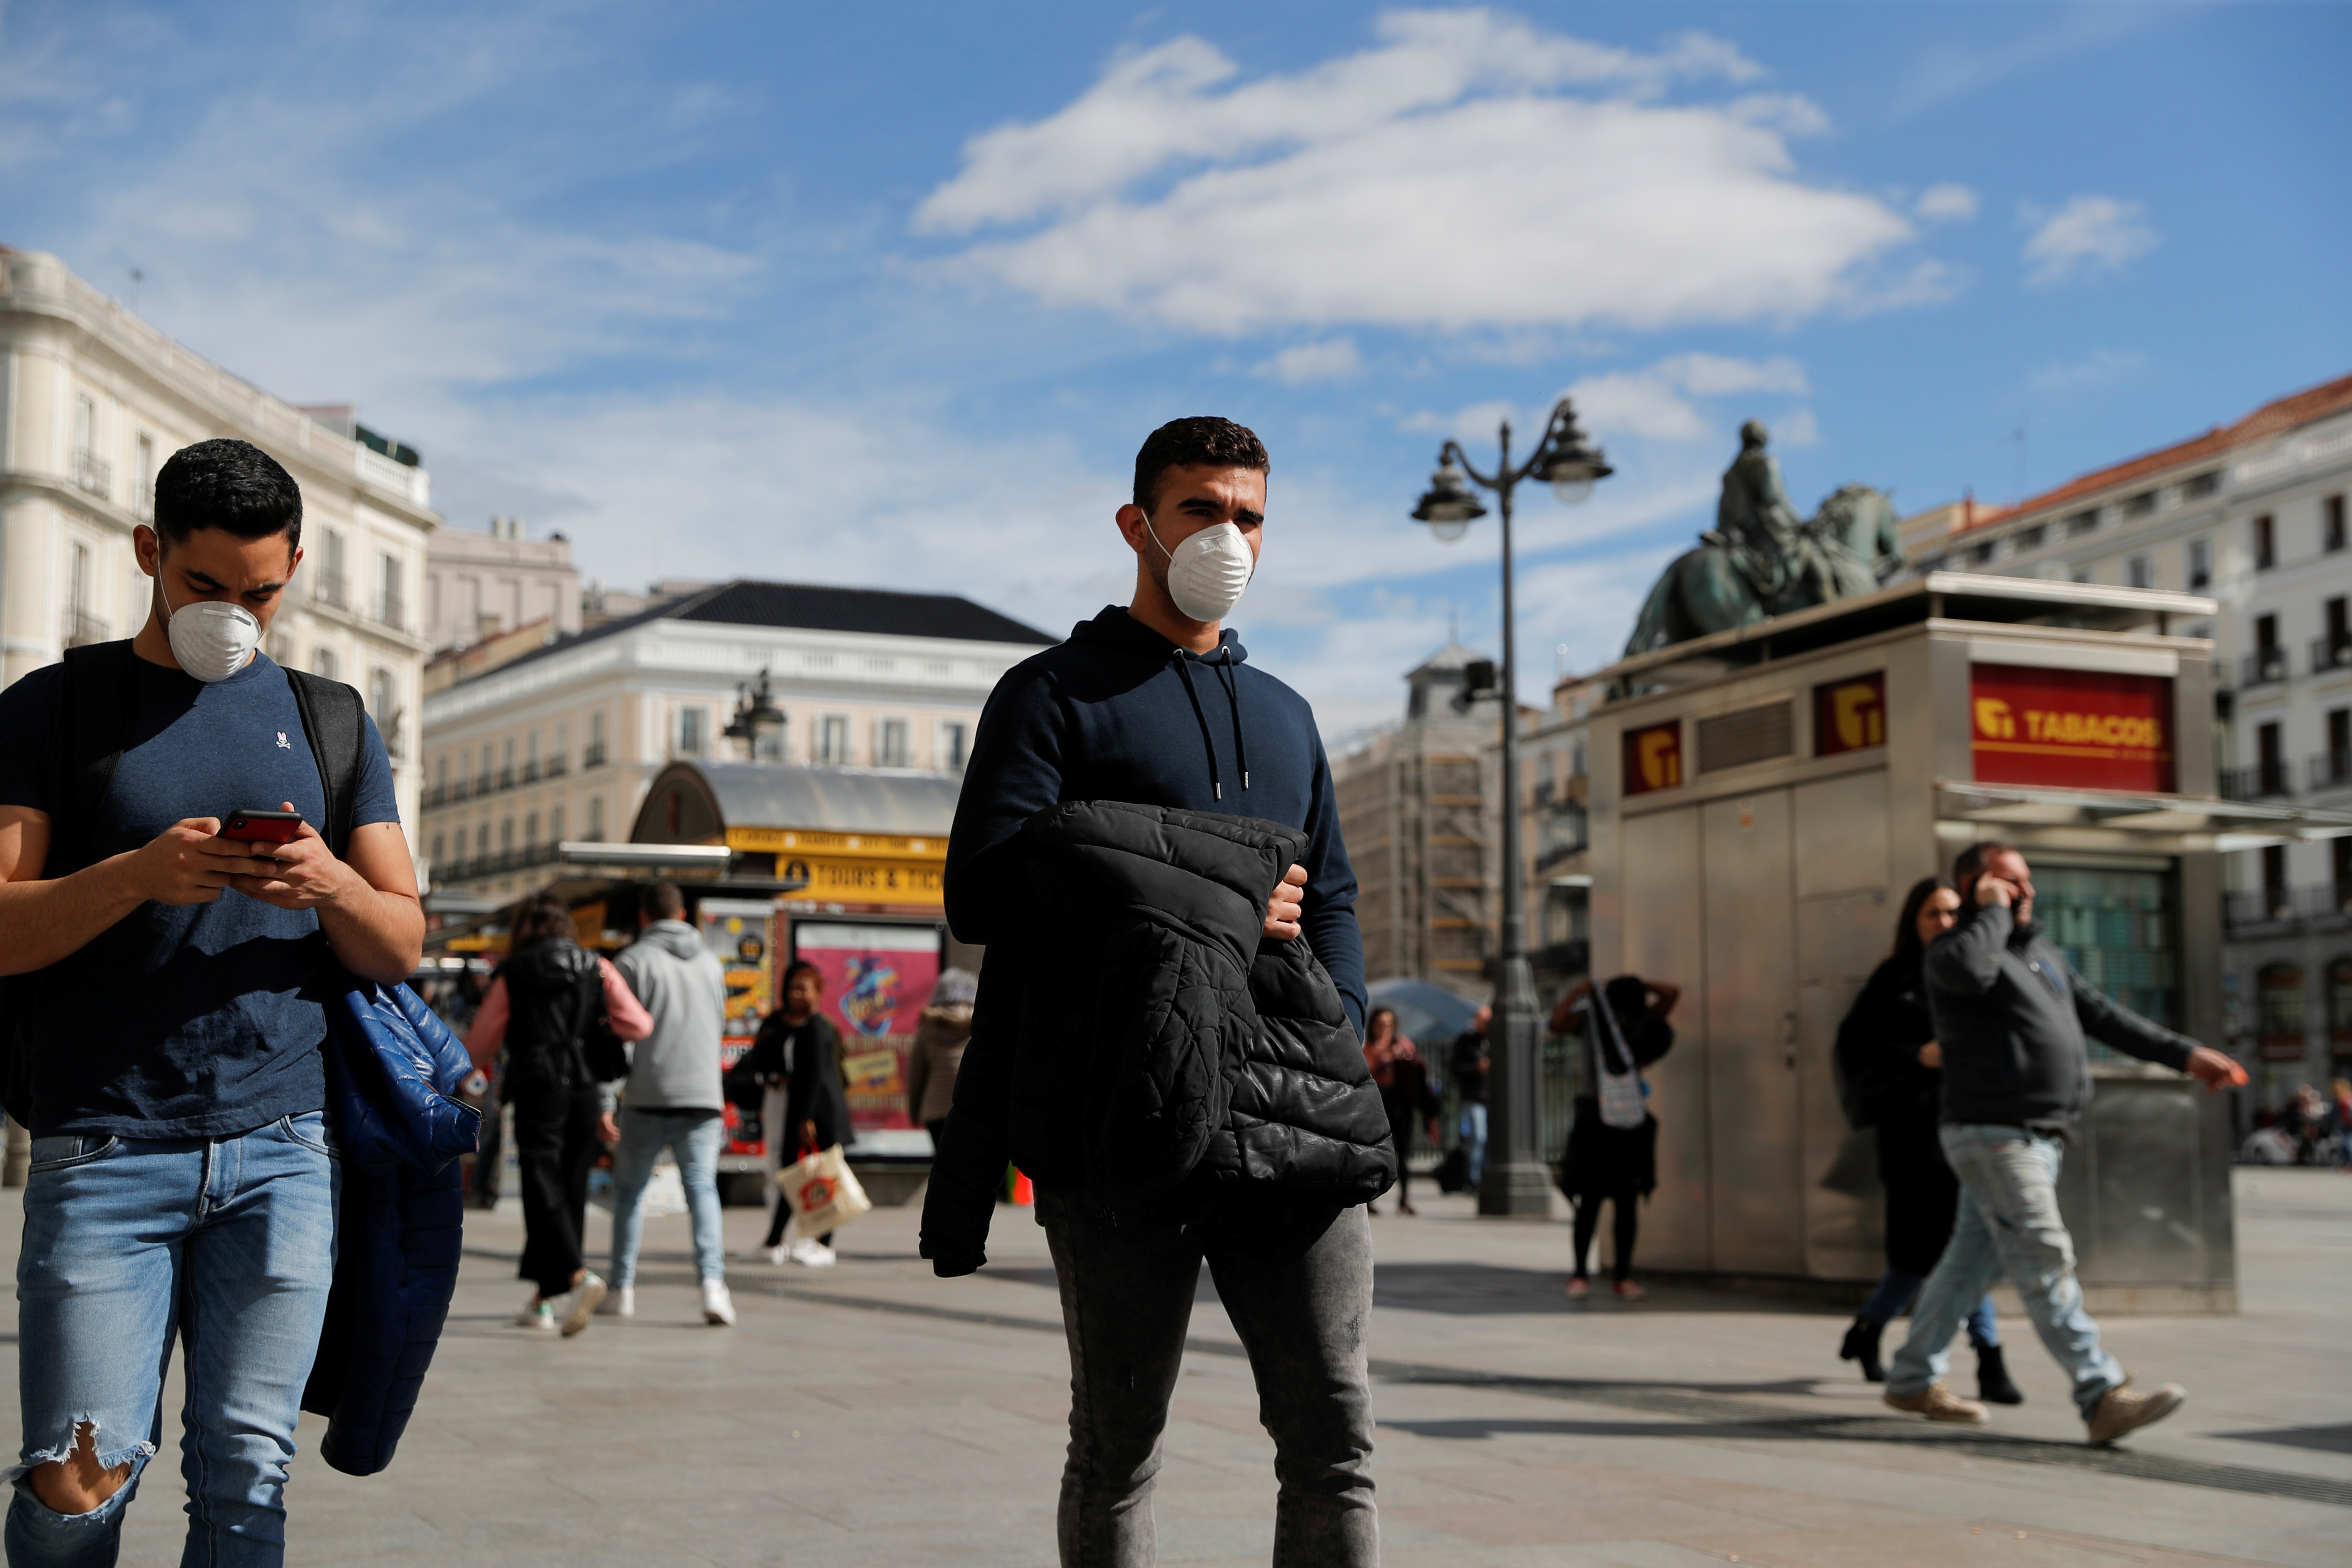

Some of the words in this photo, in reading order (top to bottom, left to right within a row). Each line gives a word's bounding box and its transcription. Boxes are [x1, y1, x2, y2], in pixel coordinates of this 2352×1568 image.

[2023, 709, 2162, 748] TABACOS
[817, 864, 879, 889] TOURS
[886, 867, 899, 890] &
